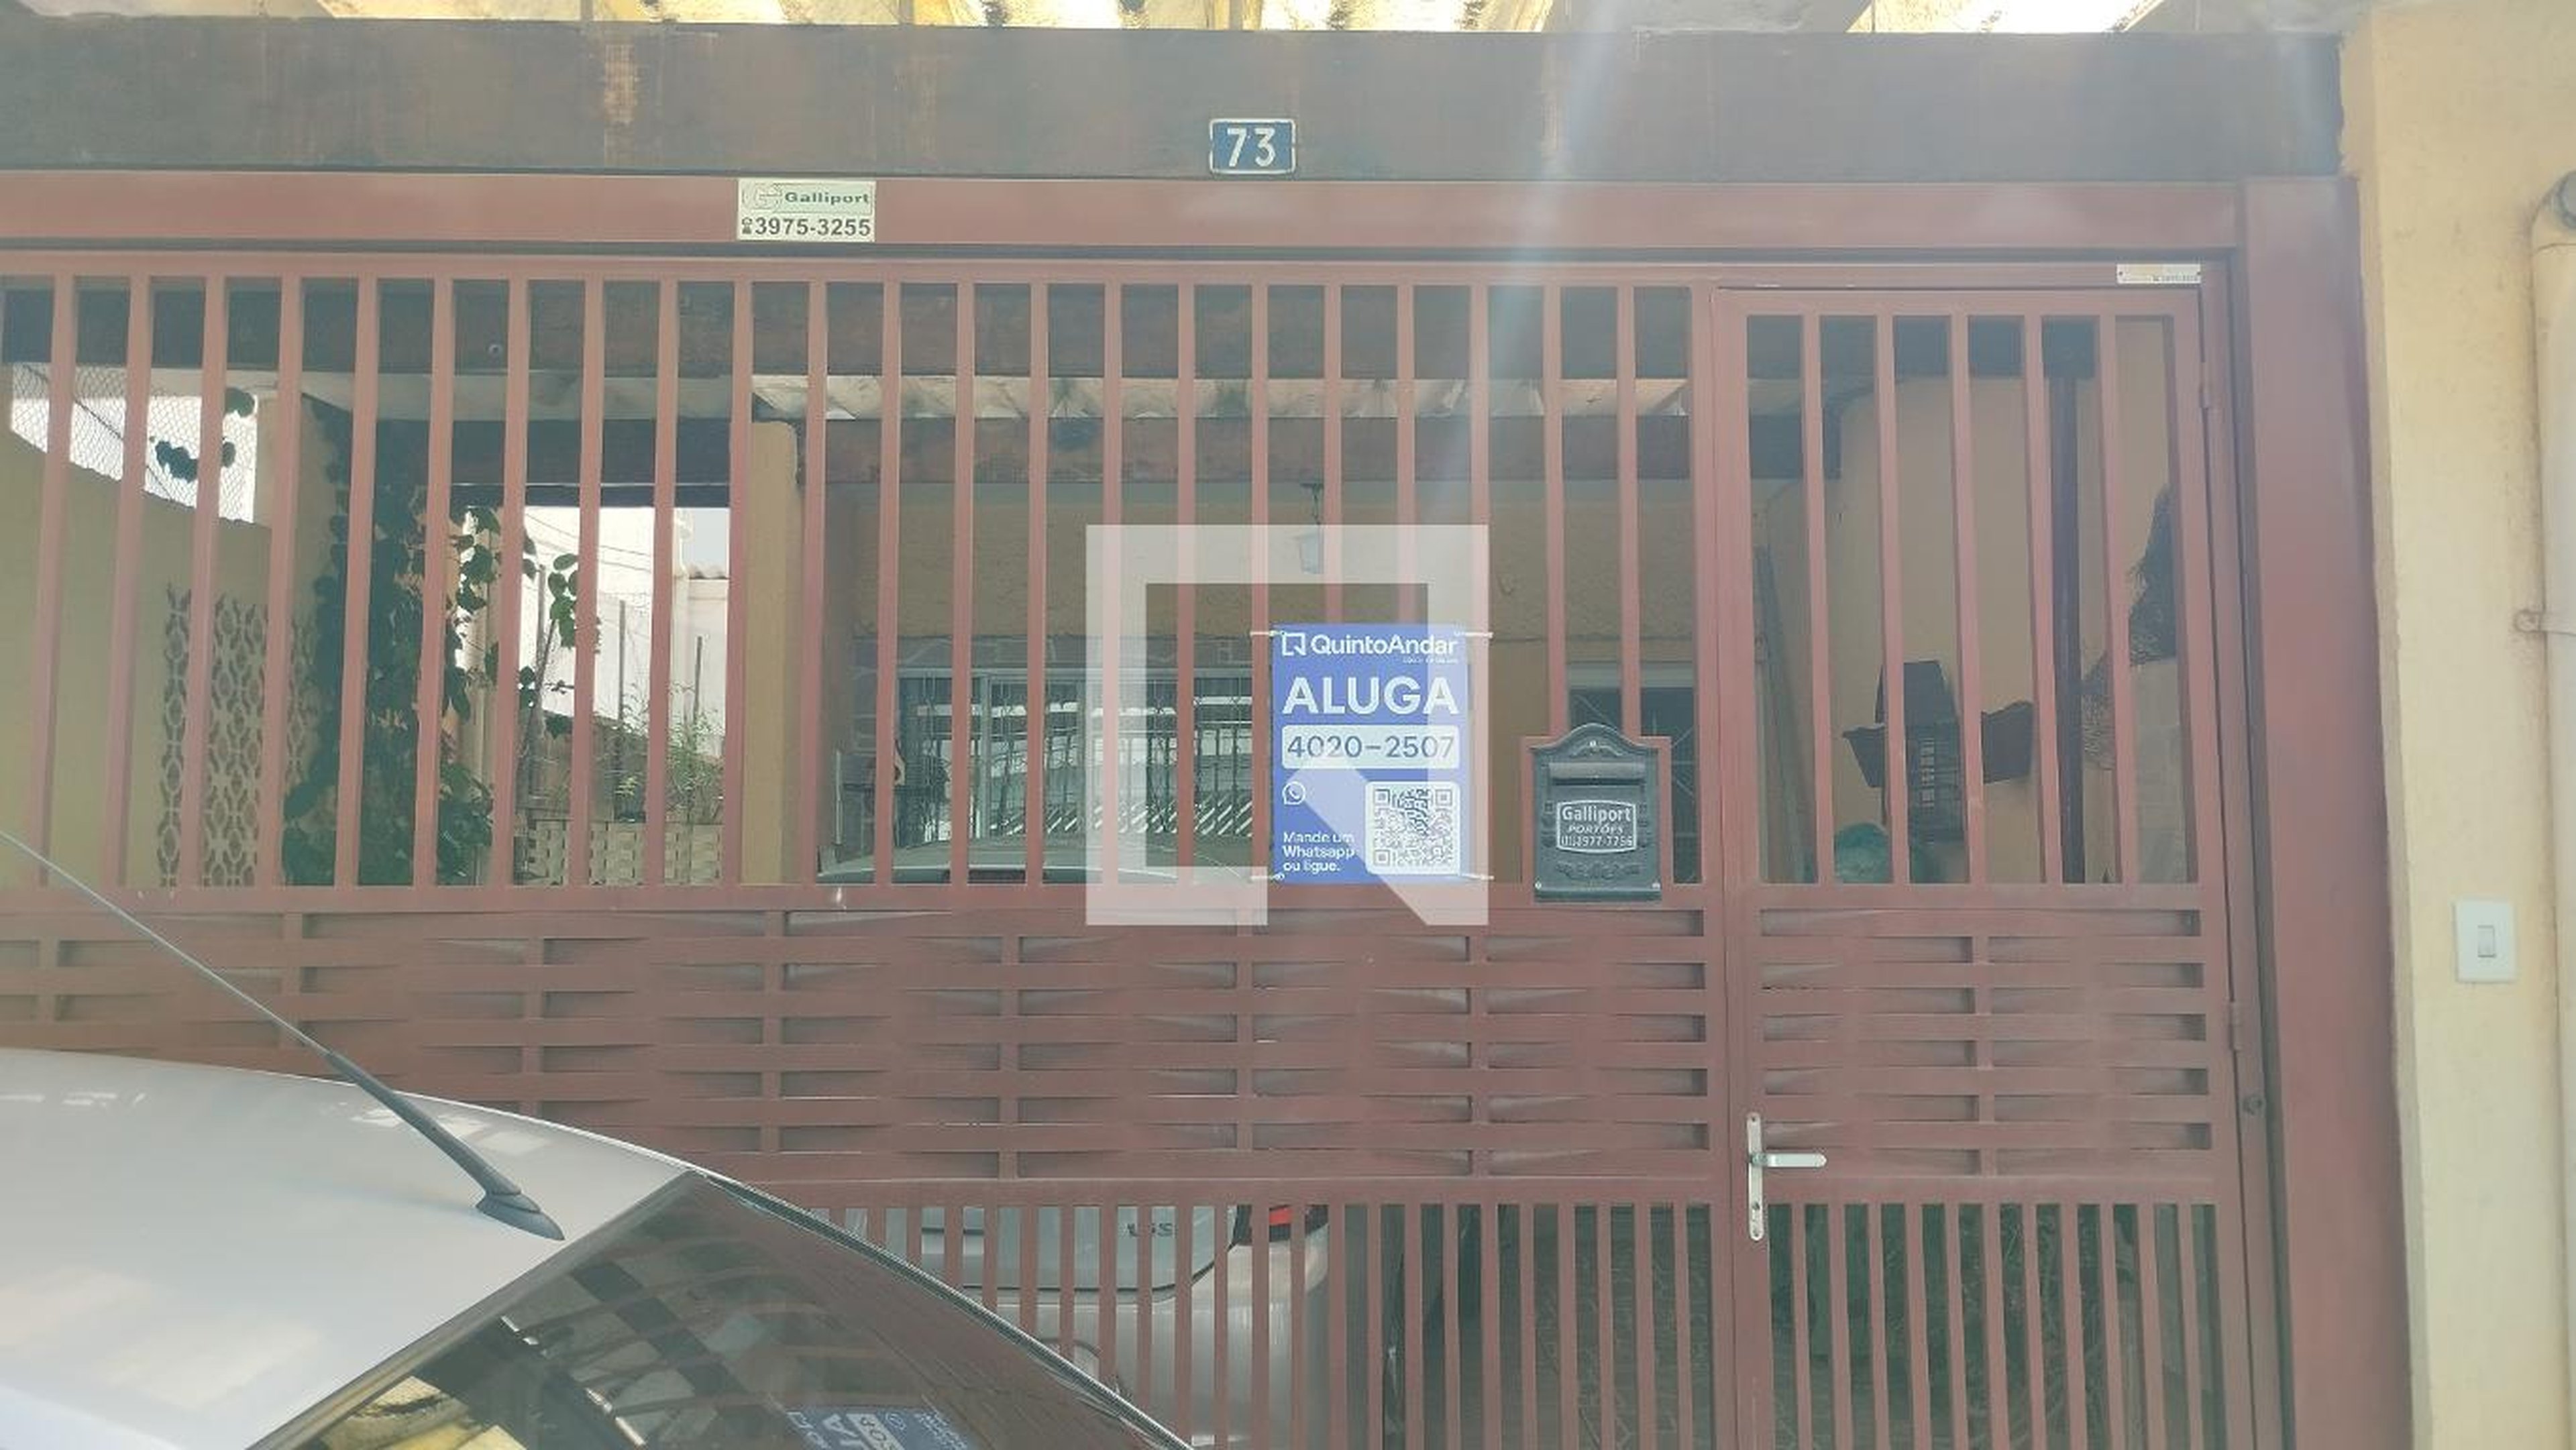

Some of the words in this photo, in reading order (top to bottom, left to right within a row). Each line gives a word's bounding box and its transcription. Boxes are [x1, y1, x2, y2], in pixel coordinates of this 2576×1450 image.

[1227, 127, 1275, 167] 73
[784, 192, 870, 205] Galliport
[755, 217, 871, 236] 3975-3255
[1310, 634, 1458, 656] QuintoAndar
[1282, 676, 1460, 715] ALUGA
[1287, 735, 1455, 759] 4020-2507
[1562, 805, 1632, 824] Galliport
[1283, 830, 1330, 843] Mande
[1332, 833, 1356, 843] um
[1282, 845, 1356, 860] Whatsapp
[1283, 862, 1301, 871] ou
[1303, 859, 1341, 875] ligue.
